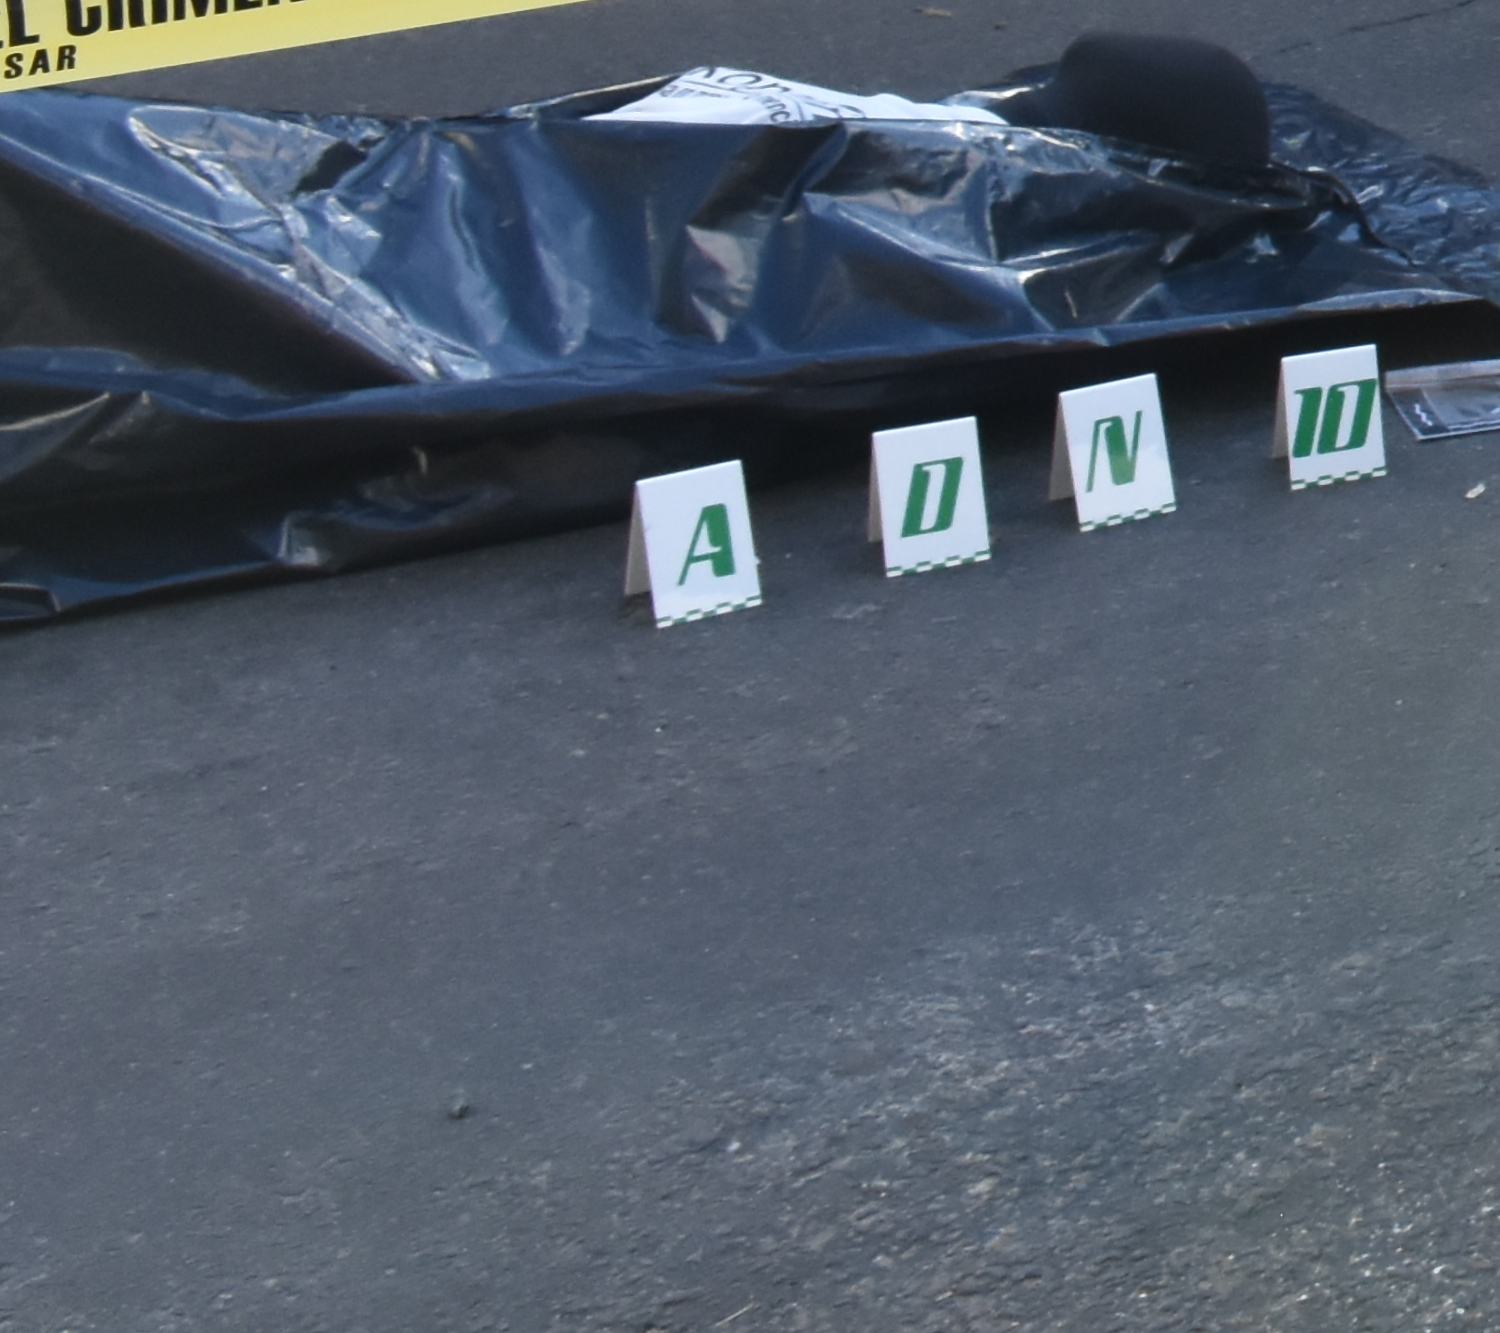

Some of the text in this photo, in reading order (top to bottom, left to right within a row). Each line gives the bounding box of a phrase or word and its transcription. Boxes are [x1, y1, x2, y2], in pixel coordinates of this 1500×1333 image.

[1086, 411, 1143, 493] N
[901, 457, 964, 538] D
[677, 503, 736, 587] A
